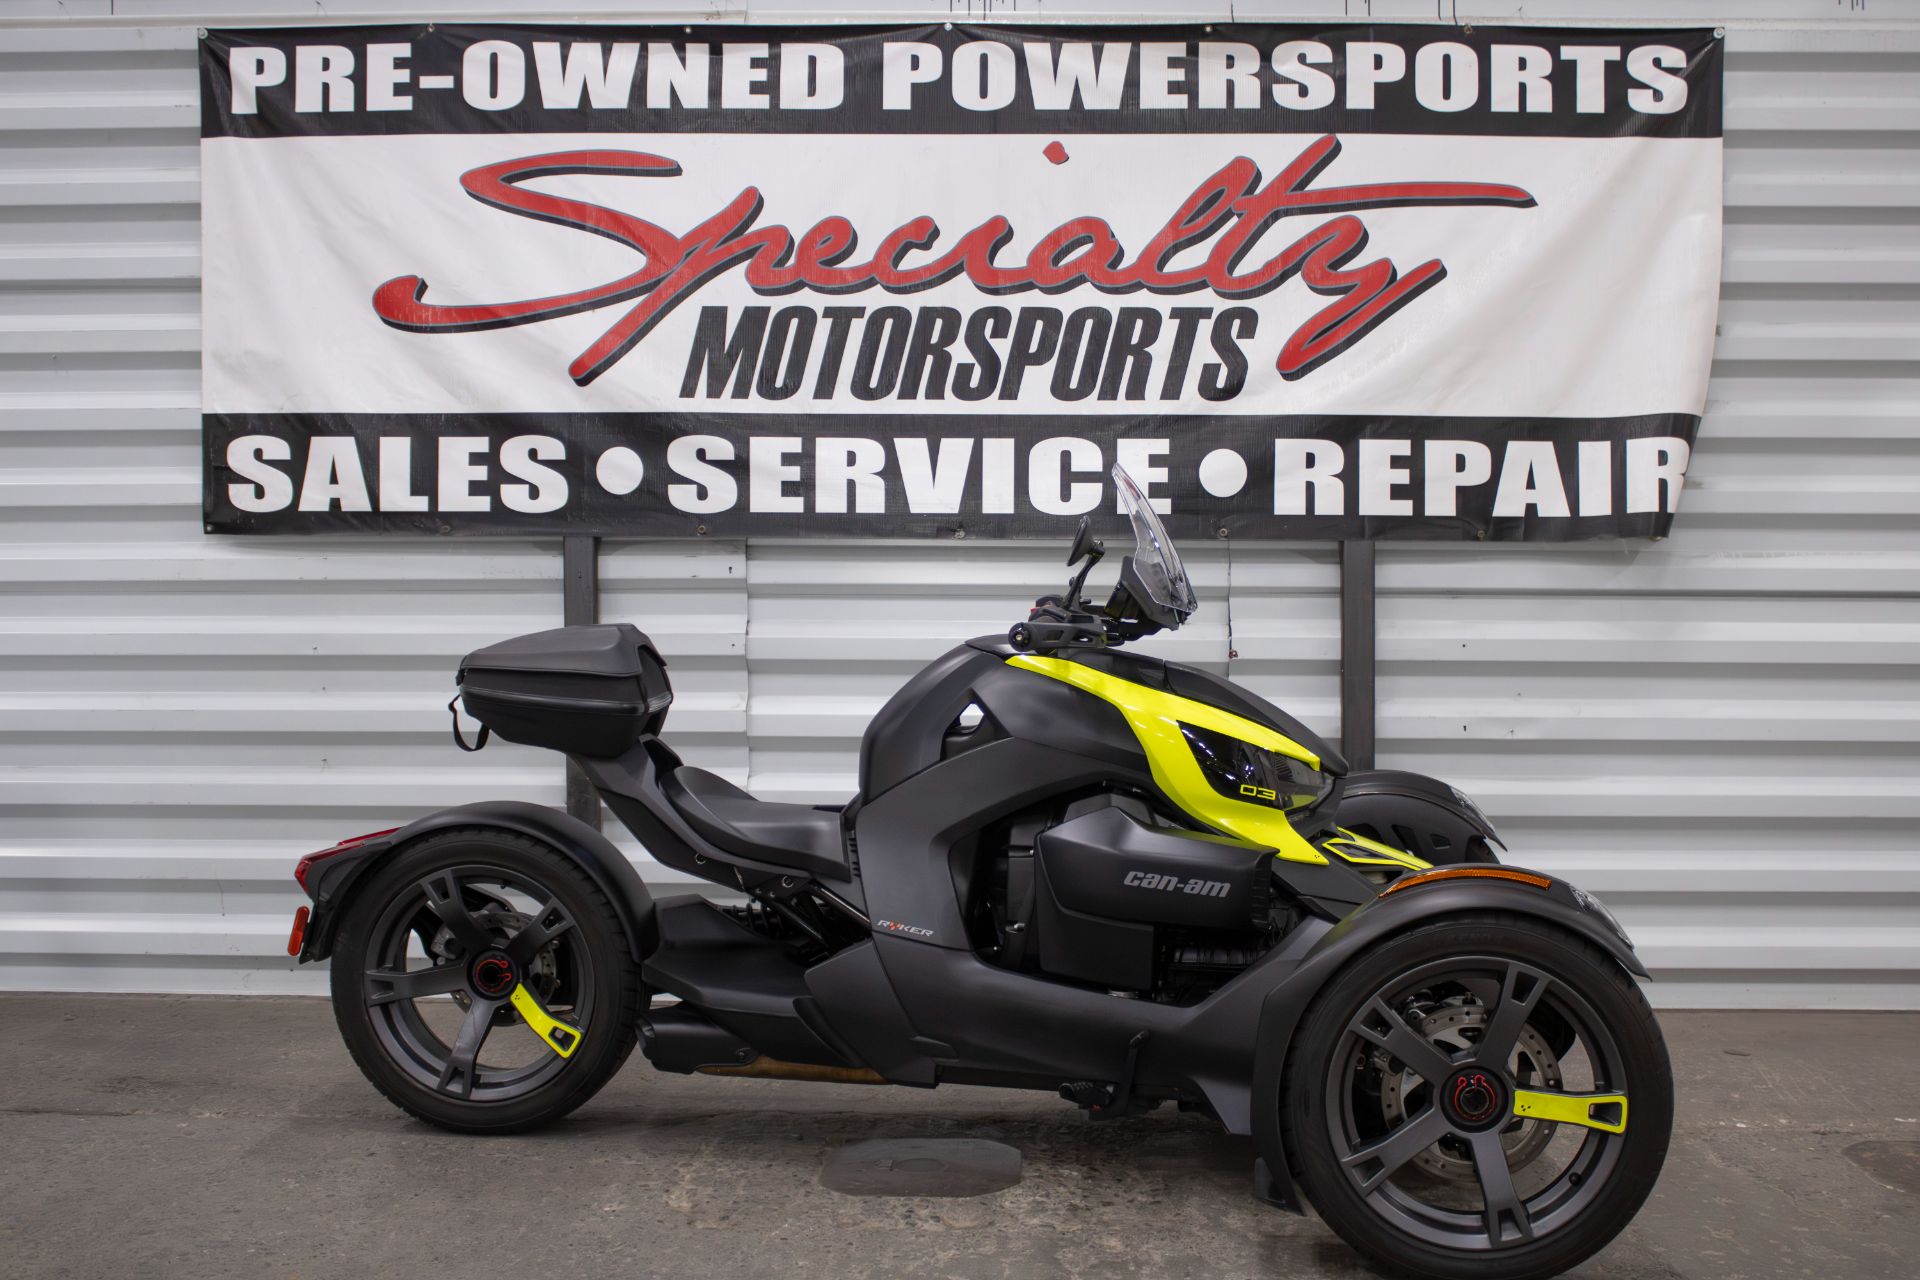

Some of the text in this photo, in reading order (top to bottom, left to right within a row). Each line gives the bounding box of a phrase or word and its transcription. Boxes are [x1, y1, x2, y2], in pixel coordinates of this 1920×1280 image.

[227, 40, 1689, 116] PRE-OWNED POWERSPORTS
[372, 133, 1538, 387] Specialty
[679, 305, 1259, 403] MOTORSPORTS
[227, 434, 1691, 518] SALES SERVICE REPAIR
[1240, 784, 1276, 801] 03
[1123, 870, 1231, 898] can-am
[877, 919, 934, 937] RYKER
